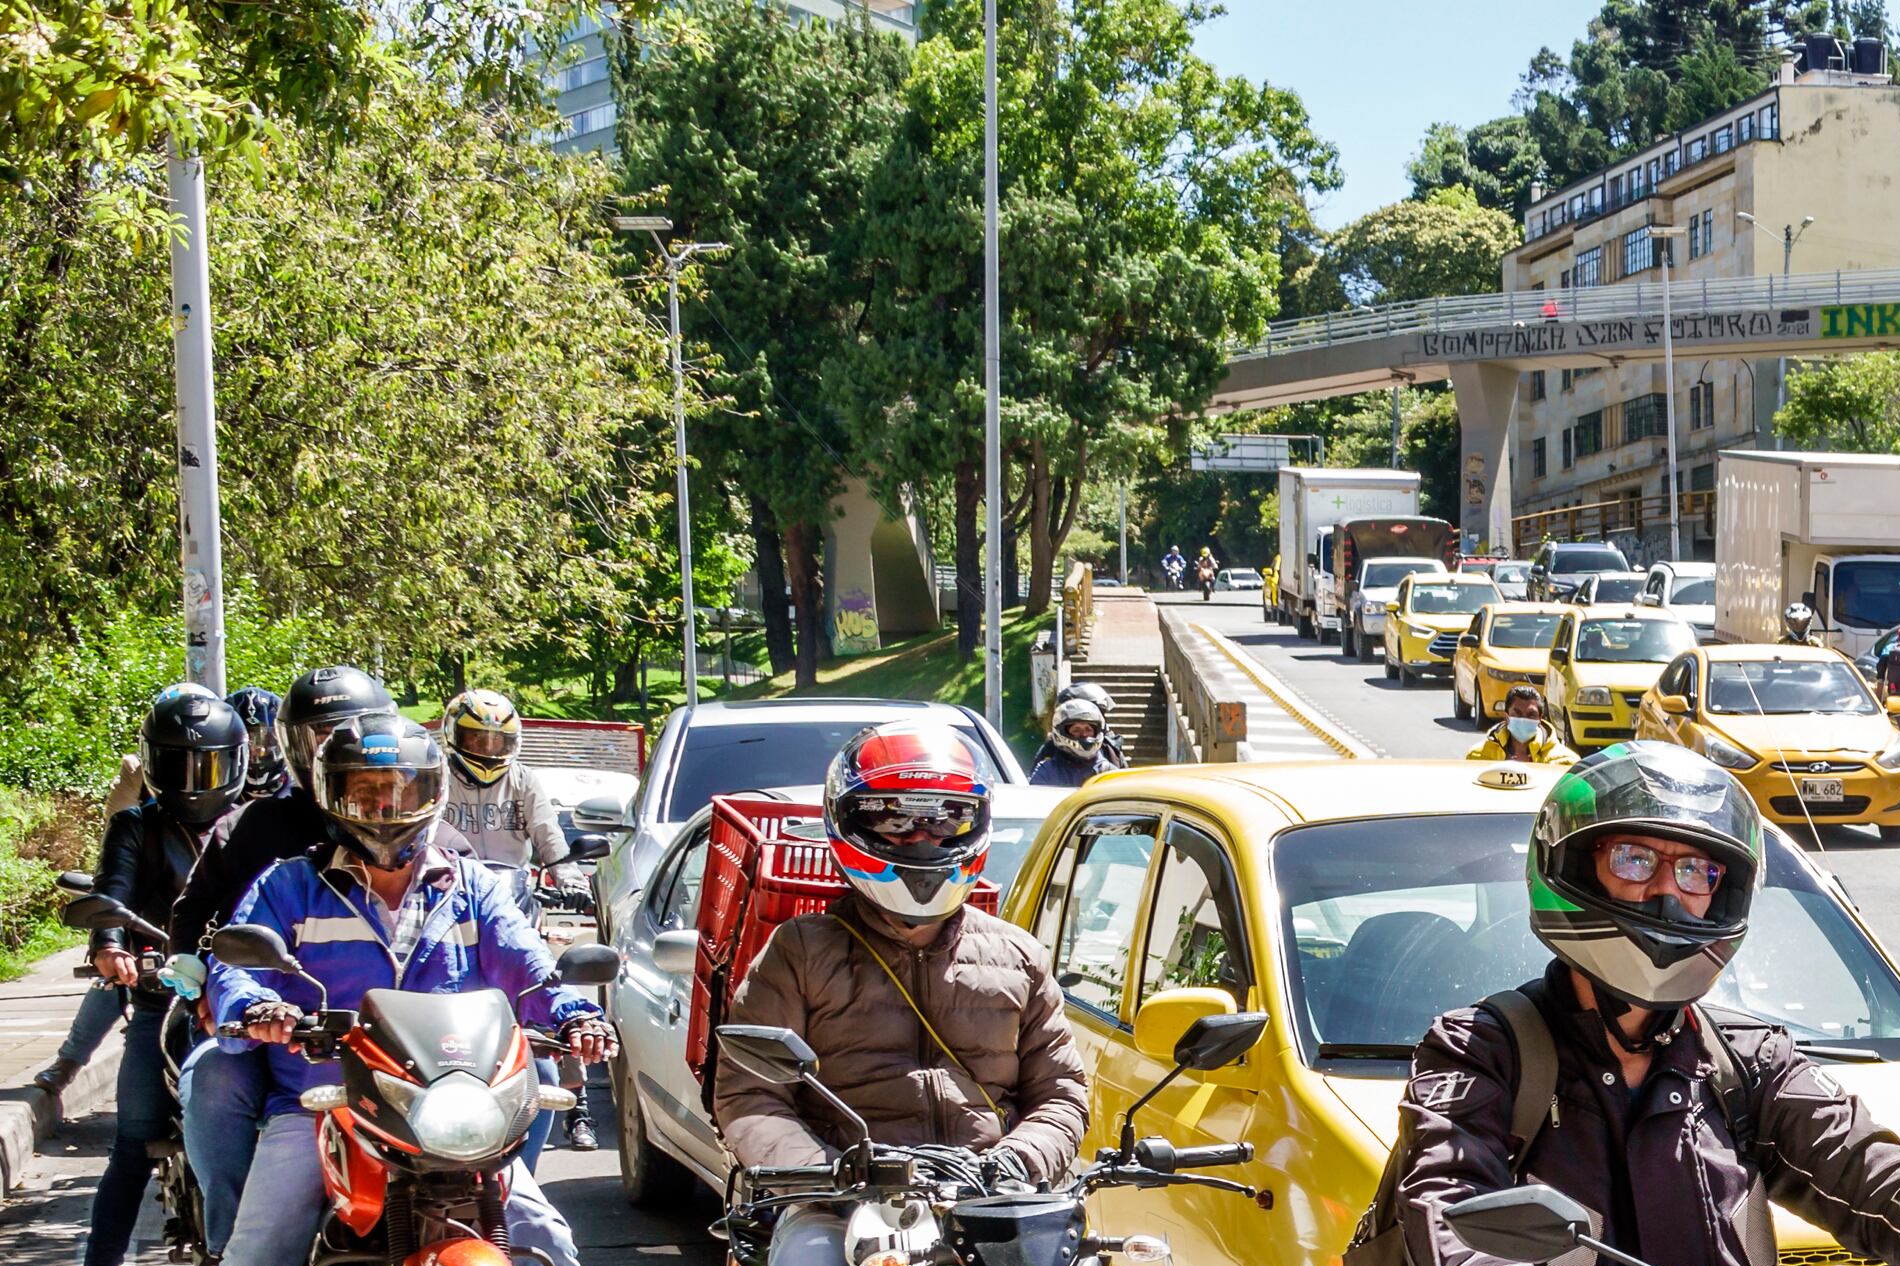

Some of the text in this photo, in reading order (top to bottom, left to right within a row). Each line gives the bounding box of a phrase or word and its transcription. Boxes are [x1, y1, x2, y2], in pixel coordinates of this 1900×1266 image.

[898, 772, 948, 781] SHAFT
[1499, 772, 1527, 785] TAXI
[1823, 783, 1842, 796] 682
[437, 1060, 477, 1068] SUZUKI
